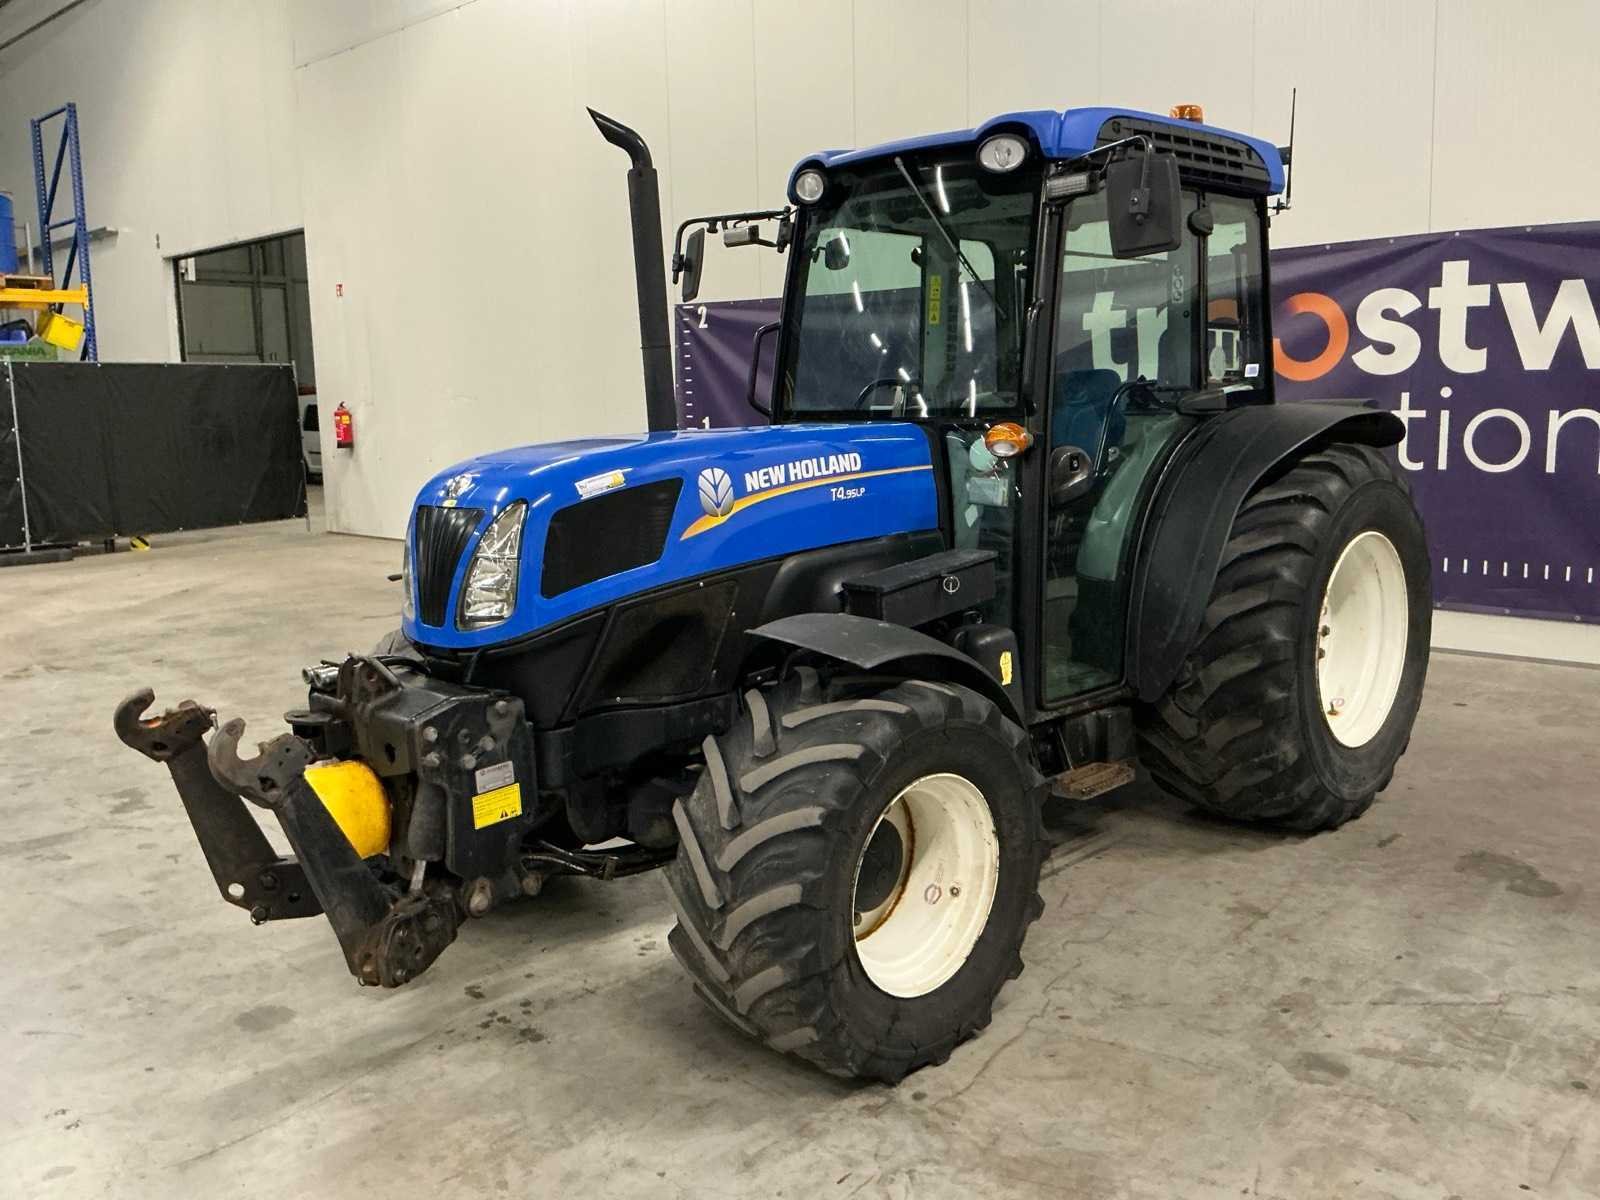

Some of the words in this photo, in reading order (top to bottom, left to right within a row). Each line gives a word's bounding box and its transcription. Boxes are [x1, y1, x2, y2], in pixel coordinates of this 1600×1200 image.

[698, 306, 708, 328] 2
[702, 416, 710, 430] 1
[1391, 386, 1600, 473] tion
[744, 464, 785, 492] NEW
[788, 452, 861, 482] HOLLAND
[830, 487, 866, 501] T4.95LP
